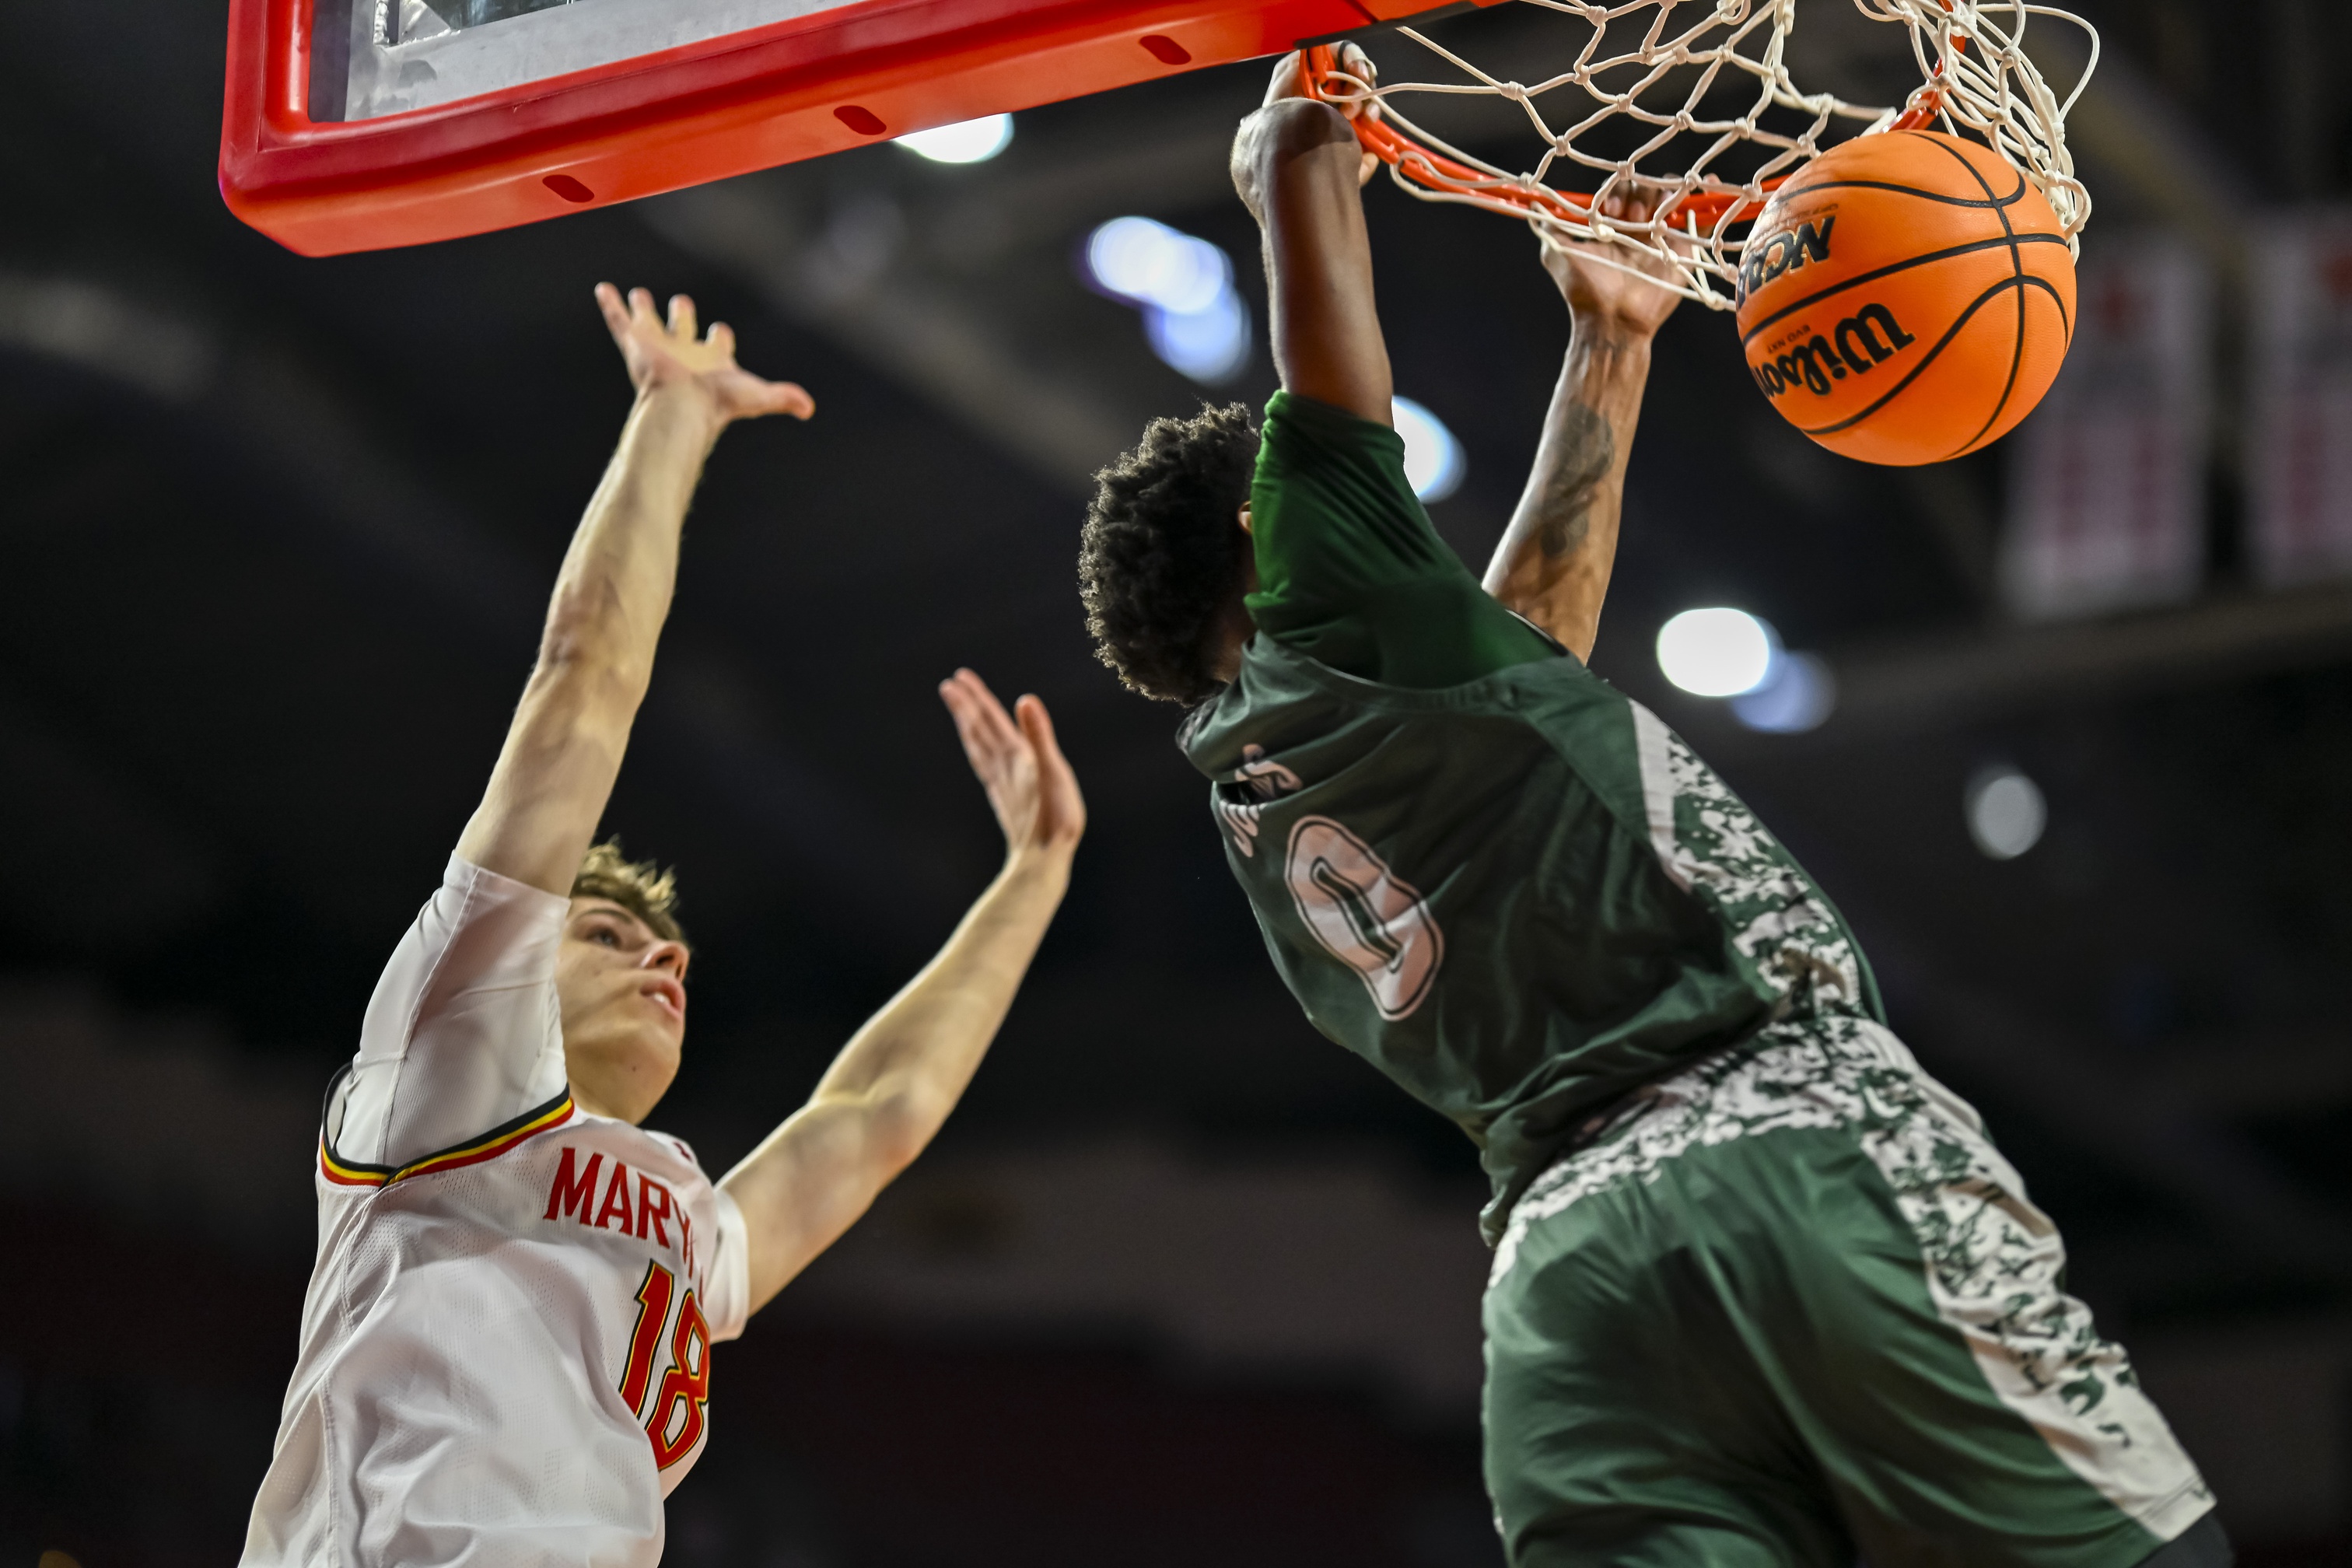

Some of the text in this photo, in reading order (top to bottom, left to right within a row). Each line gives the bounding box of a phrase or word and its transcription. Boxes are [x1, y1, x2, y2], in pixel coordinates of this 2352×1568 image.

[1752, 303, 1916, 398] Wilson
[1767, 324, 1811, 355] EVO NXT
[1284, 814, 1444, 1020] 0
[619, 1258, 709, 1472] 18
